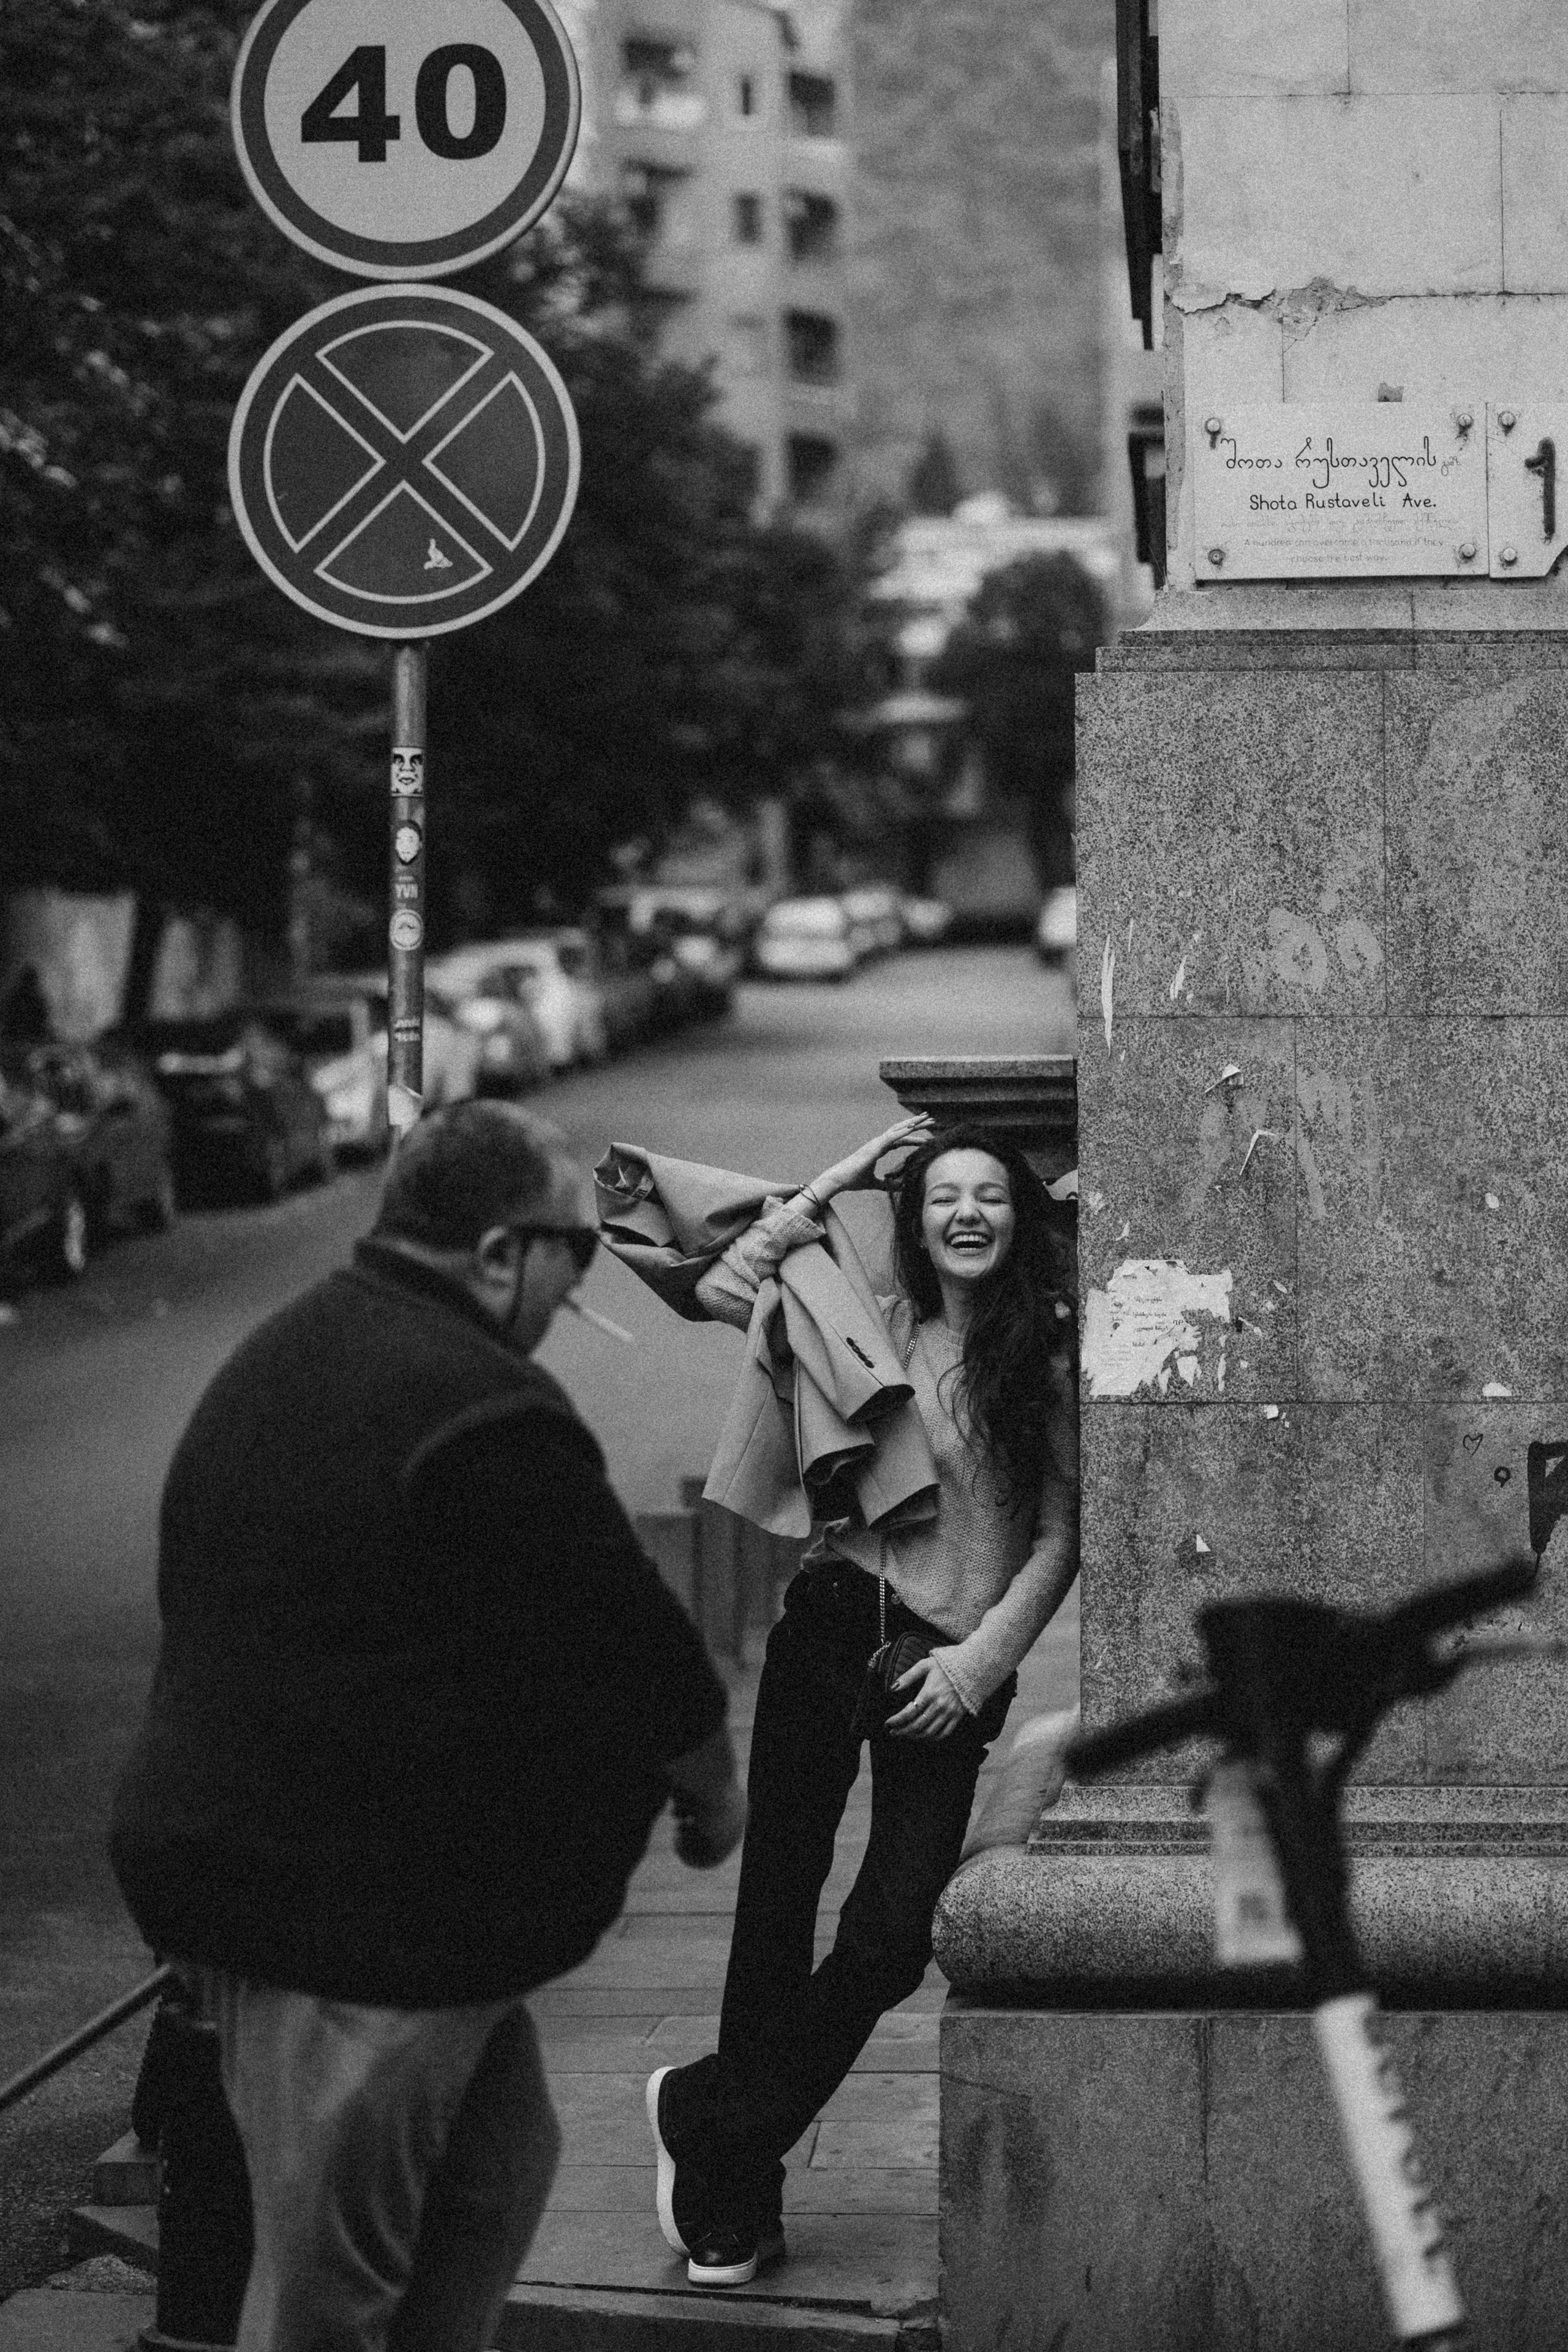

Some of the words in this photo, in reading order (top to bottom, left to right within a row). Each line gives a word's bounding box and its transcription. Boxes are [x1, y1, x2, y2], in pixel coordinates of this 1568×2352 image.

[301, 43, 507, 163] 40
[1220, 438, 1283, 469] შოთა
[1295, 435, 1437, 489] რუსთაველის
[1249, 494, 1298, 511] Shota
[1305, 492, 1386, 509] Rustaveli
[1402, 492, 1437, 508] Ave.
[1524, 436, 1556, 545] 1
